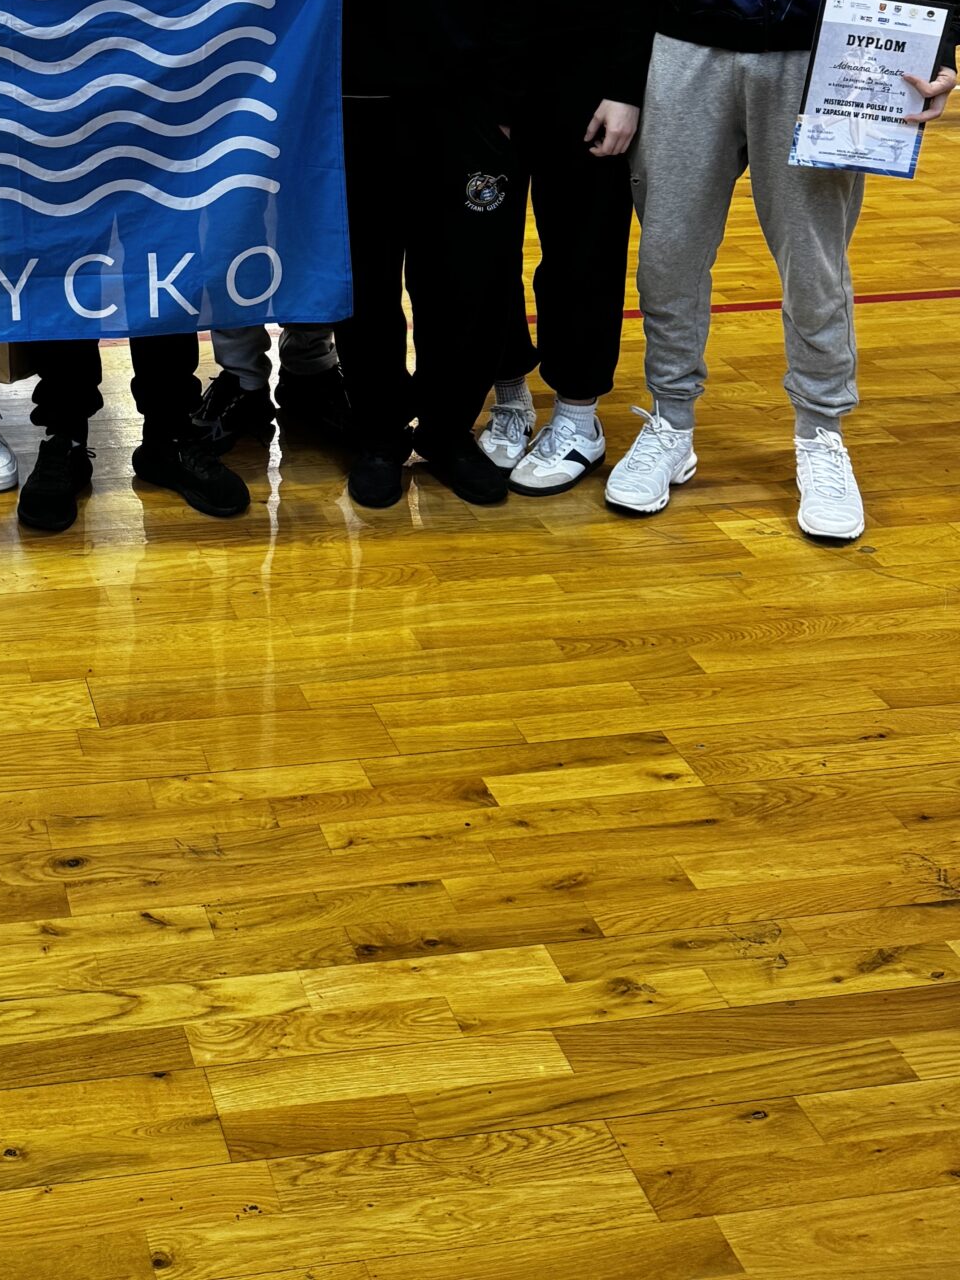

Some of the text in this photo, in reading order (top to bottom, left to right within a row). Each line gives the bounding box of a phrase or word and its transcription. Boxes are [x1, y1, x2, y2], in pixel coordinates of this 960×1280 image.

[846, 34, 907, 53] DYPLOM
[823, 98, 864, 109] MISTRZOSTWA
[866, 103, 888, 113] POLSKI
[822, 108, 851, 117] ZAPASACH
[860, 112, 879, 121] STYLU
